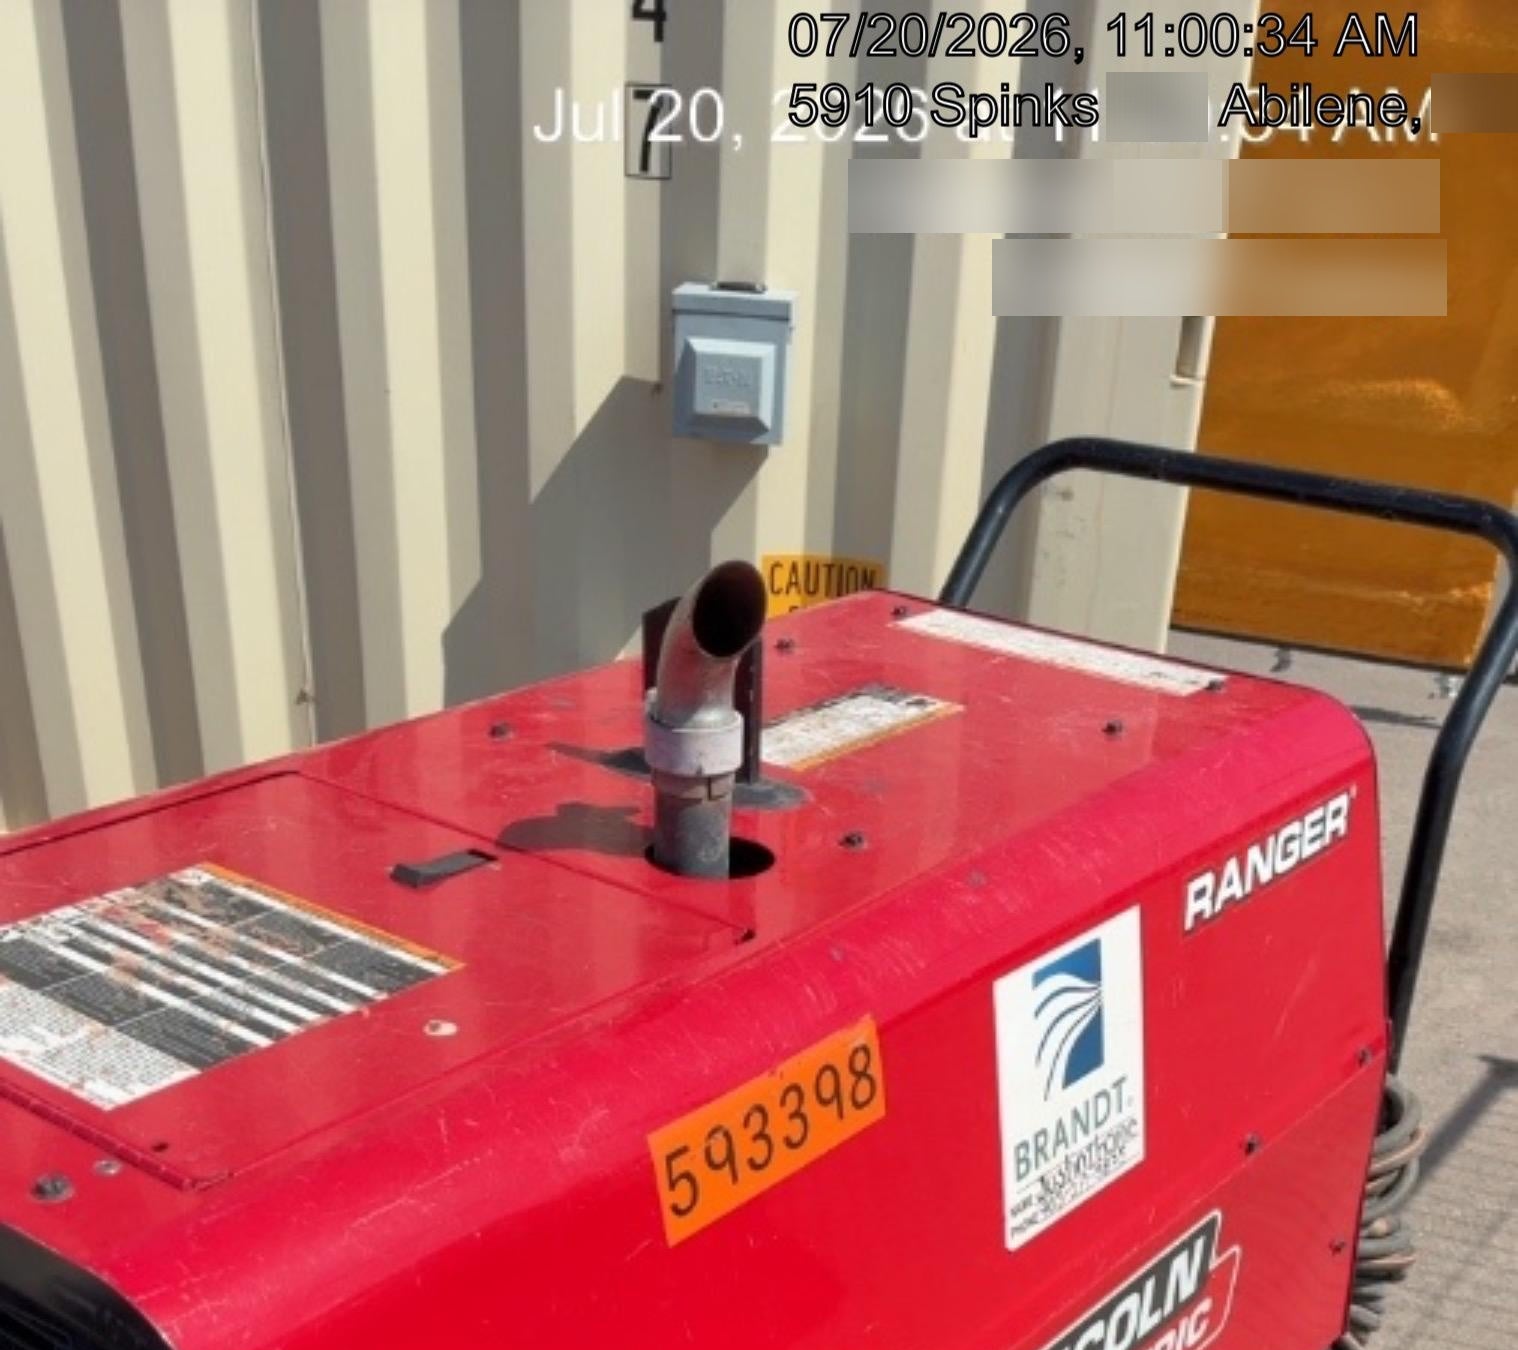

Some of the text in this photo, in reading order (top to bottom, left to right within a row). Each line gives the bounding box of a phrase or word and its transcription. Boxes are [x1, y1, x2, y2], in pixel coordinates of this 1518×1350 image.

[769, 560, 877, 598] CAUTION
[1183, 791, 1350, 932] RANGER
[664, 1043, 878, 1218] 593398
[1013, 1075, 1128, 1183] BRANDT
